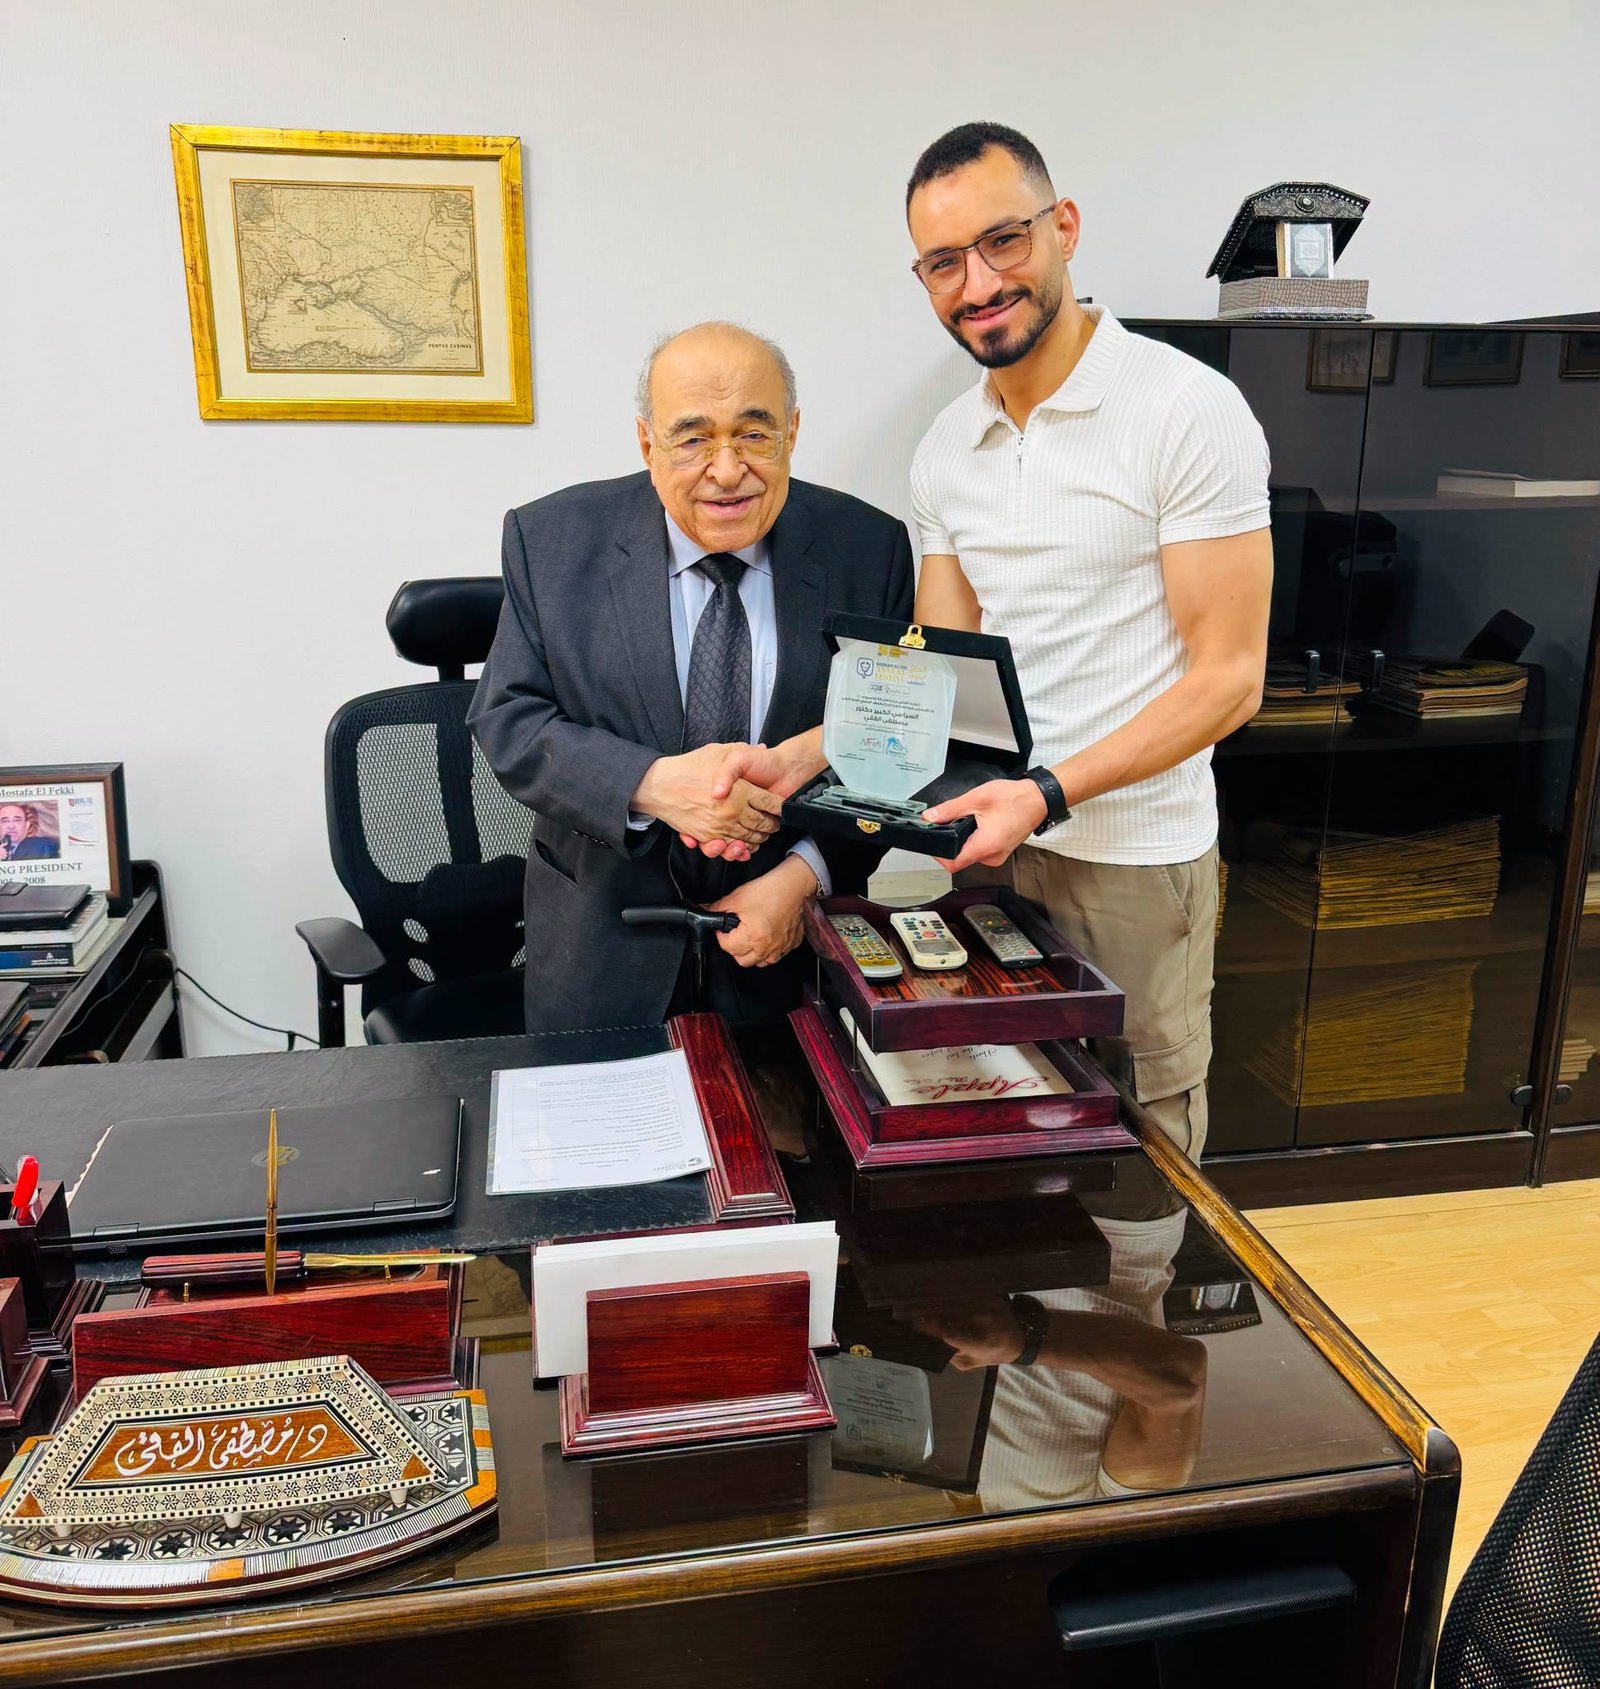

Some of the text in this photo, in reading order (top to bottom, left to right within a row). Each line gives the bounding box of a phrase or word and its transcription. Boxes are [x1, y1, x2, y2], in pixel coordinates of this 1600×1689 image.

[36, 787, 46, 796] El
[49, 786, 75, 796] Fekki
[19, 862, 83, 874] PRESIDENT
[23, 876, 46, 885] 2008
